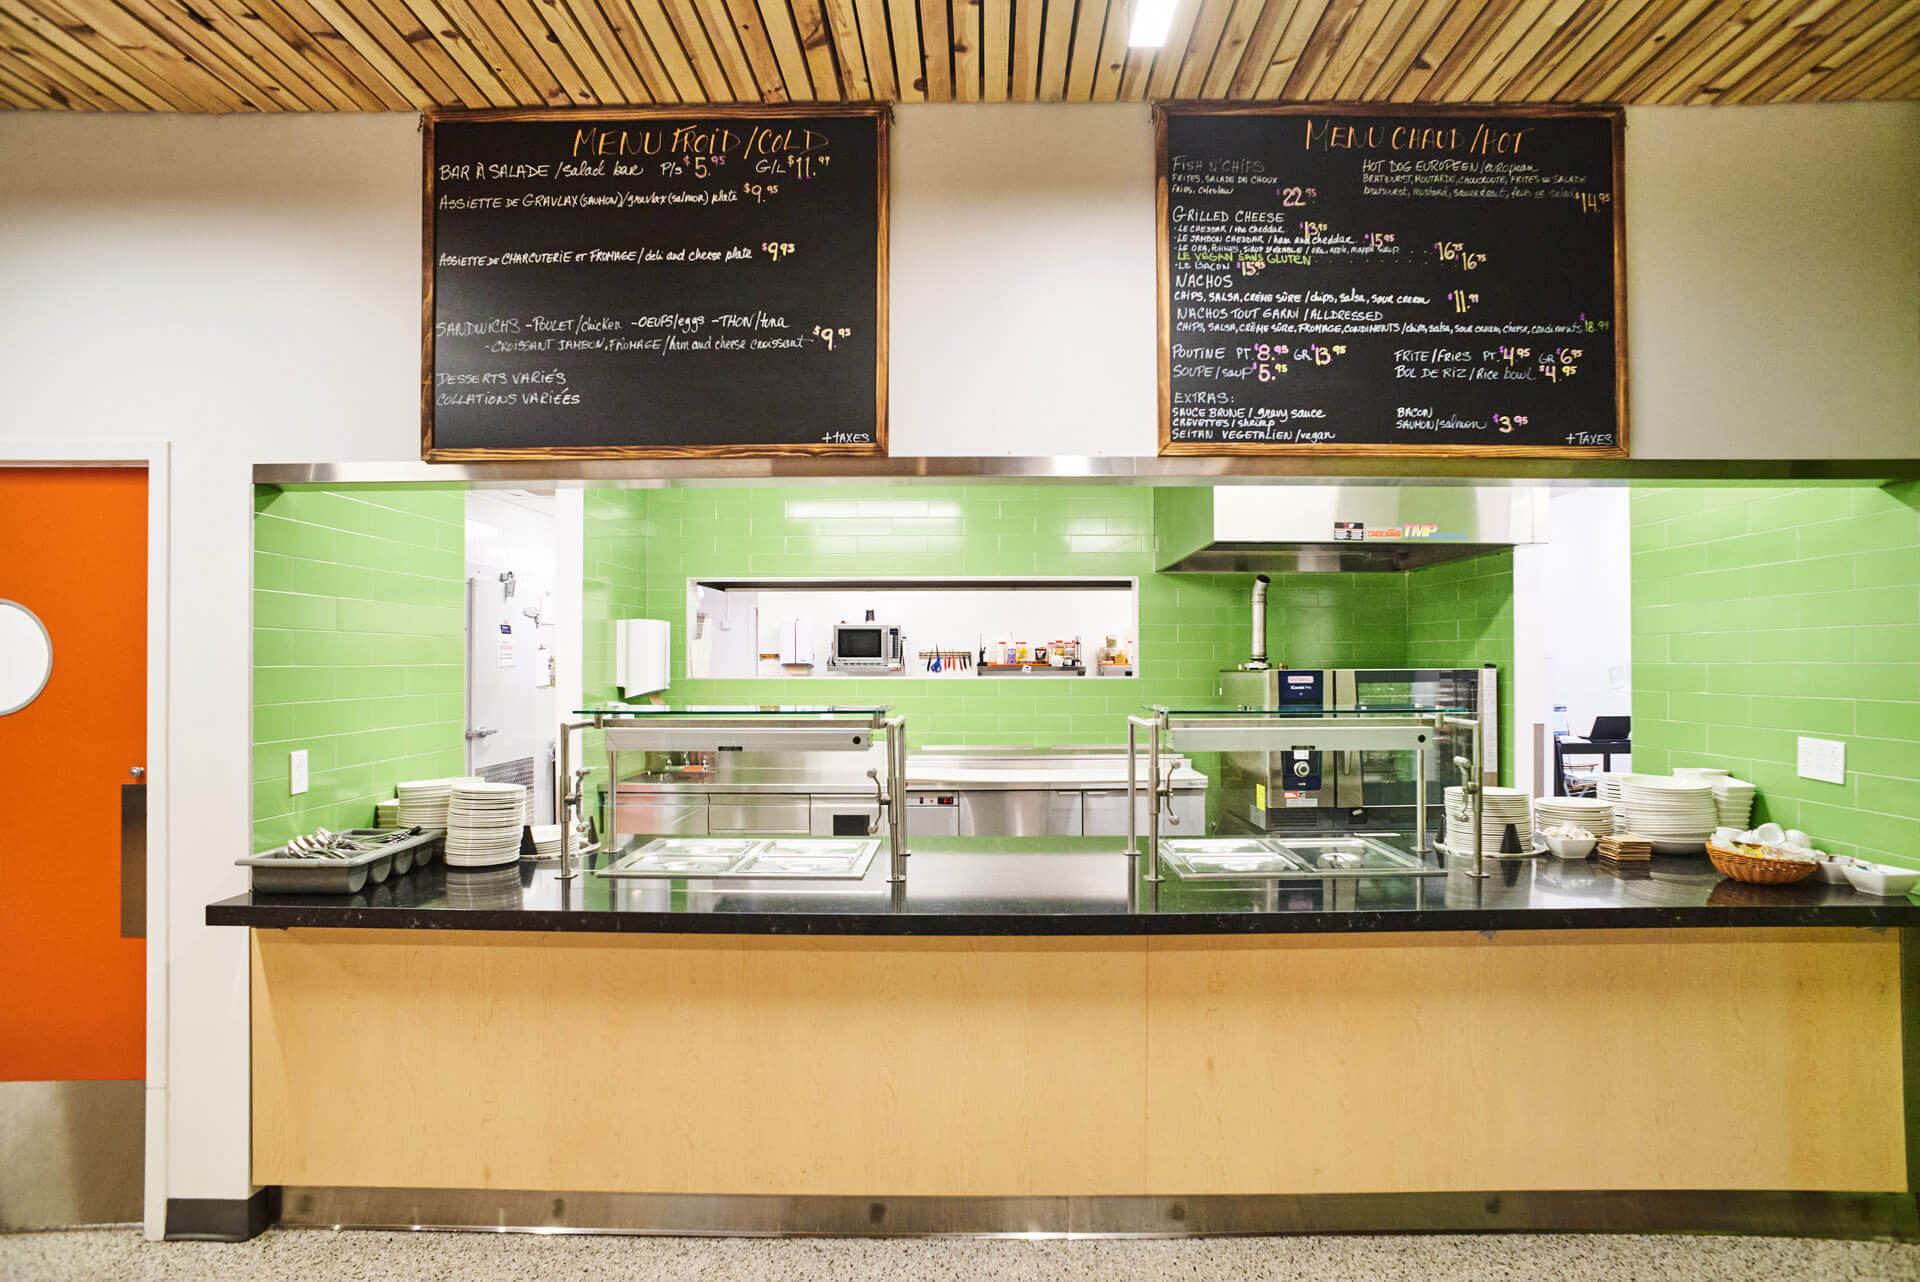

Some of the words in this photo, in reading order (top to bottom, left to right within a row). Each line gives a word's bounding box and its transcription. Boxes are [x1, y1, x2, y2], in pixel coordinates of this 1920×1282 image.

[573, 127, 662, 157] MENU
[1305, 119, 1384, 151] MENU
[1391, 126, 1465, 150] CHAUD
[439, 164, 470, 181] BAR
[489, 164, 551, 179] SALADE
[613, 160, 644, 176] bar
[1362, 159, 1384, 173] HOT
[1390, 160, 1412, 173] DOG
[1205, 174, 1234, 184] SALADE
[1237, 175, 1248, 184] DE
[1250, 175, 1278, 184] CHOUX
[440, 194, 502, 210] ASSIETTE
[505, 198, 520, 207] DE
[711, 189, 738, 204] plate
[1172, 205, 1229, 222] GRILLED
[1235, 210, 1285, 223] CHEESE
[1190, 225, 1227, 233] CHEDDAR
[1248, 224, 1285, 233] cheddar
[1190, 234, 1222, 243] JAMBON
[1224, 235, 1265, 243] CHEDDAR
[1273, 235, 1291, 244] ham
[1294, 235, 1310, 244] and
[1312, 233, 1354, 244] cheddar
[440, 253, 487, 266] ASSIETTE
[487, 257, 499, 266] DE
[666, 248, 685, 261] and
[688, 248, 722, 261] cheese
[725, 246, 752, 263] plate
[1177, 252, 1191, 260] LE
[1194, 252, 1233, 262] VEGAN
[1239, 252, 1264, 262] SANS
[1195, 261, 1230, 271] BACON
[1175, 272, 1233, 288] NACHOS
[1371, 294, 1394, 304] sour
[1177, 306, 1228, 320] NACHOS
[1231, 308, 1260, 319] TOUT
[692, 336, 711, 350] and
[715, 336, 746, 350] cheese
[750, 335, 810, 350] croissant
[1172, 344, 1225, 359] POUTINE
[436, 371, 507, 386] DESSERTS
[1394, 365, 1416, 379] BOL
[1420, 368, 1439, 378] DE
[1503, 366, 1536, 380] bowl
[1174, 392, 1235, 404] EXTRAS:
[1171, 407, 1206, 418] SAUCE
[1208, 407, 1246, 418] BRUNE
[1254, 407, 1288, 422] gravy
[1290, 408, 1327, 418] sauce
[1396, 407, 1433, 418] BACON
[1171, 418, 1230, 428] CREVETTES
[1237, 418, 1275, 432] shrimp
[1402, 523, 1437, 537] TMP
